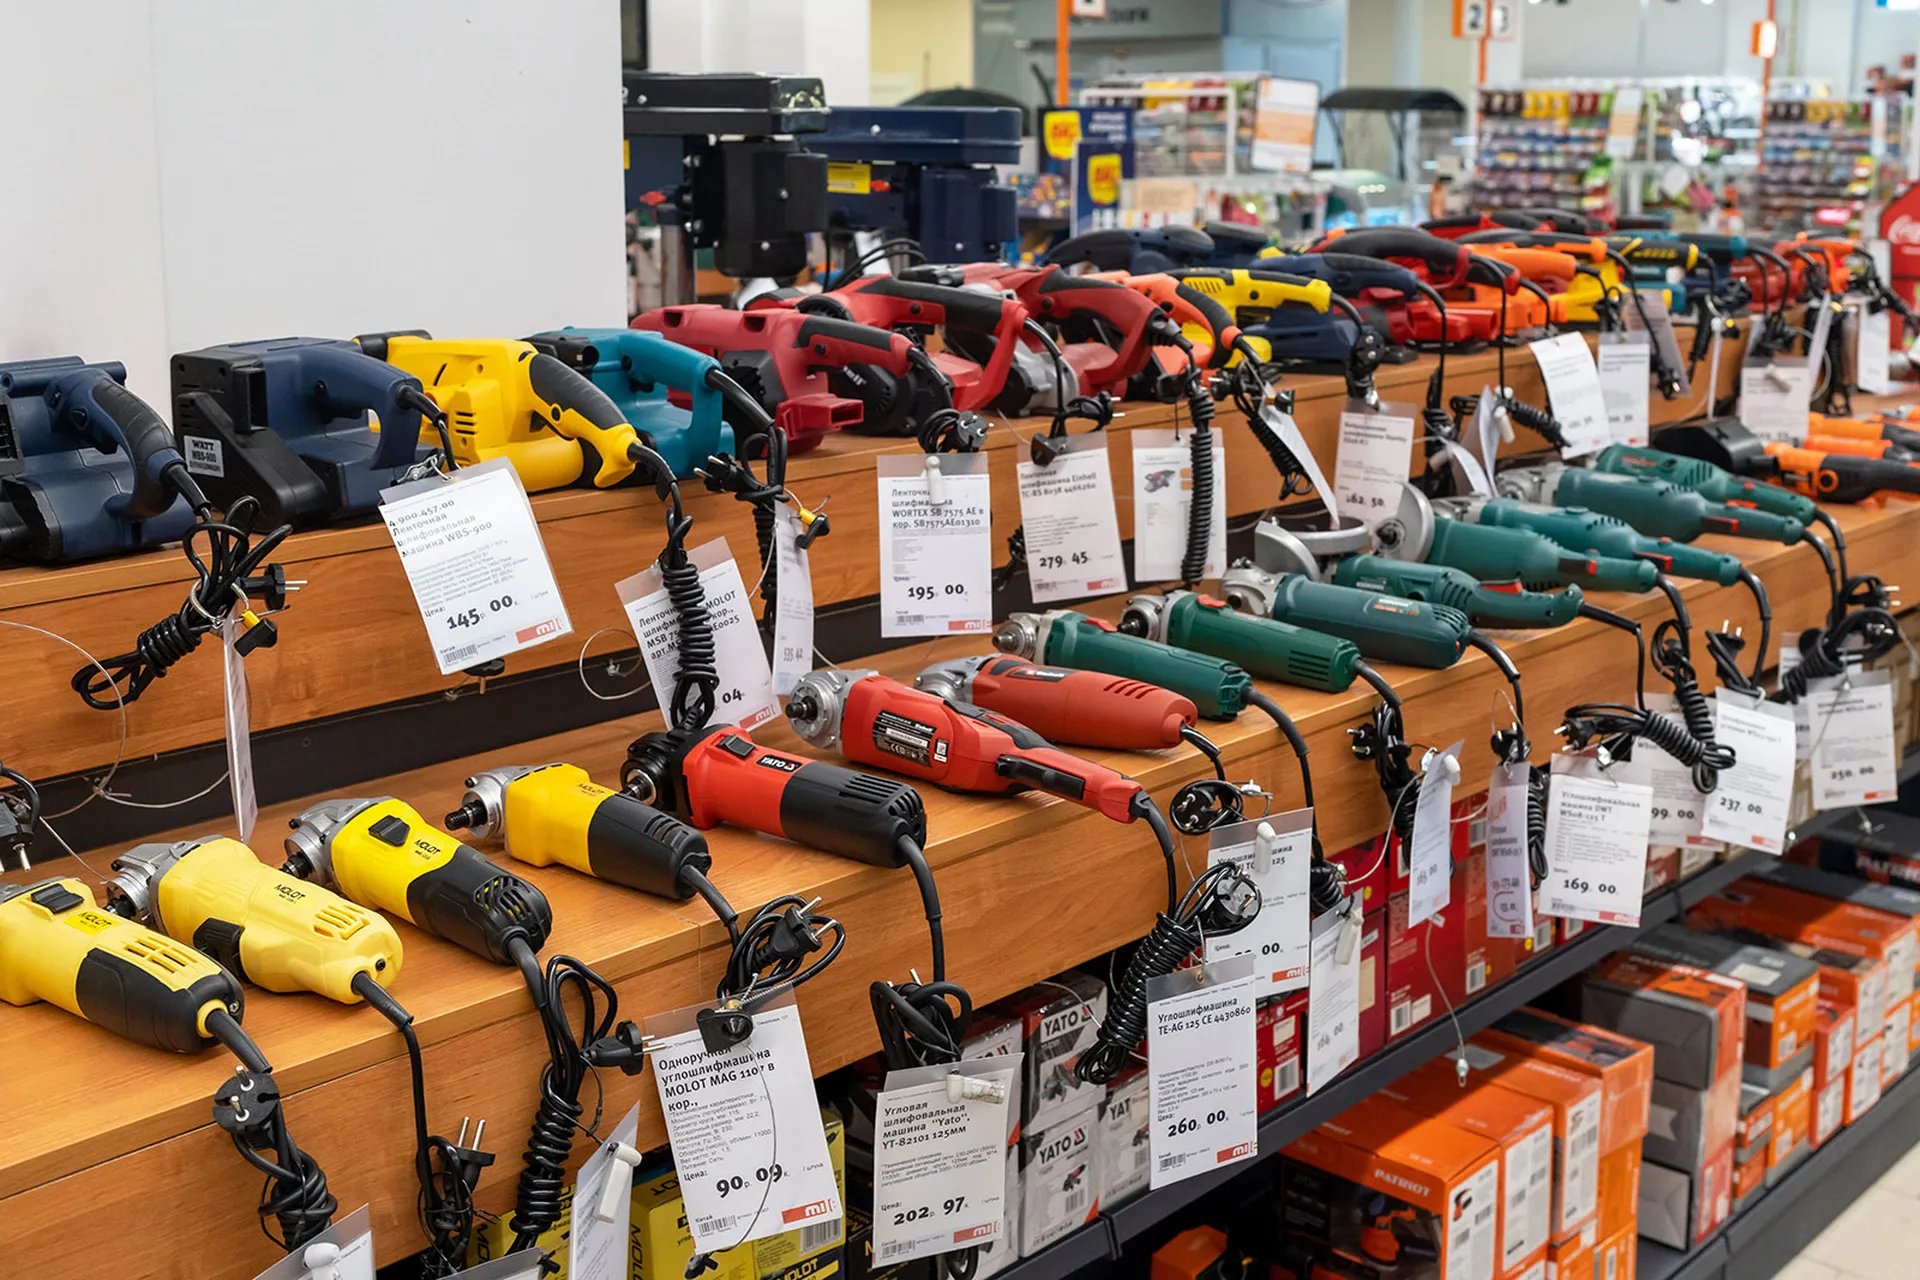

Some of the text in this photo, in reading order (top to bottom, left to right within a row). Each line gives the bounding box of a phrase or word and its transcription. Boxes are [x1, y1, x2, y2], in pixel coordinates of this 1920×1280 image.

[1469, 4, 1481, 30] 2
[191, 440, 214, 451] WATT
[891, 488, 930, 497] Ленточн
[892, 509, 928, 518] WORTEX
[930, 508, 942, 517] SB
[943, 509, 964, 518] 7575
[966, 507, 977, 516] AE
[393, 513, 447, 537] Ленточная
[445, 522, 492, 543] WBS-900
[639, 606, 677, 627] Ленточн
[643, 590, 737, 639] шлифм MOLOT
[712, 615, 740, 631] E0025
[646, 633, 668, 649] MSB
[761, 756, 787, 768] YATO
[414, 839, 441, 855] MOLOT
[1158, 998, 1238, 1024] Углошлифмашина
[1158, 1006, 1252, 1036] TE-AG 125 CE 4430860
[1044, 1011, 1078, 1036] YATO
[662, 1049, 771, 1086] углошлифмашина
[665, 1077, 707, 1098] MOLOT
[710, 1070, 737, 1087] MAG
[883, 1104, 966, 1128] шлифовальная
[884, 1102, 928, 1116] Угловая
[882, 1126, 967, 1150] YT-82101 125мм
[883, 1123, 926, 1139] машина
[1040, 1136, 1072, 1164] YATO
[683, 1169, 708, 1183] Цена:
[1374, 1168, 1430, 1198] PATRIOT
[881, 1201, 902, 1211] Цена:
